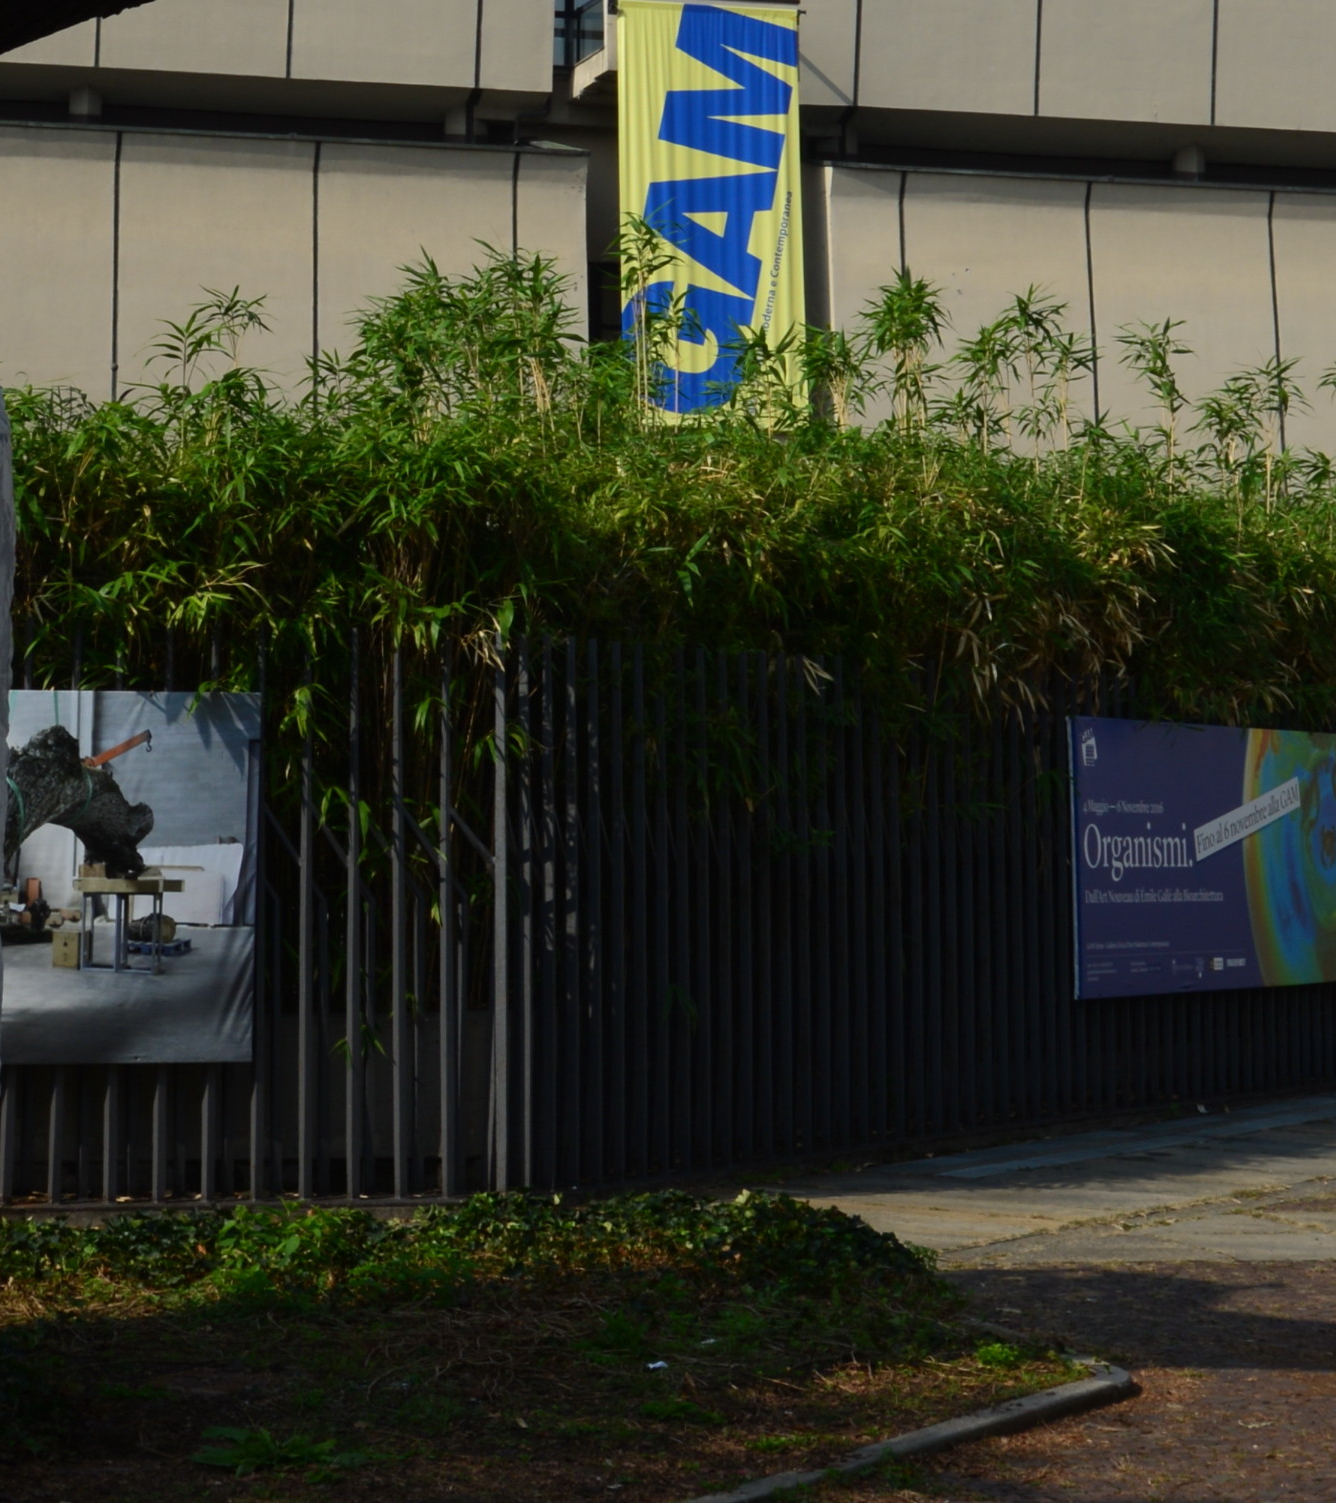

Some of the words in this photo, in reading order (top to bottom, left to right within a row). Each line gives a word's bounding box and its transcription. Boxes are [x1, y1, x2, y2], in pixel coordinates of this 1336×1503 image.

[621, 4, 799, 414] GAM
[770, 191, 793, 278] Contemporanea
[763, 290, 777, 336] oderna
[770, 280, 778, 288] e
[1083, 821, 1193, 882] Organismi.
[1196, 832, 1215, 854] Fino
[1216, 823, 1223, 844] al
[1224, 821, 1230, 840] 6
[1230, 804, 1267, 838] novembre
[1268, 795, 1280, 816] alla
[1280, 784, 1299, 809] GAM
